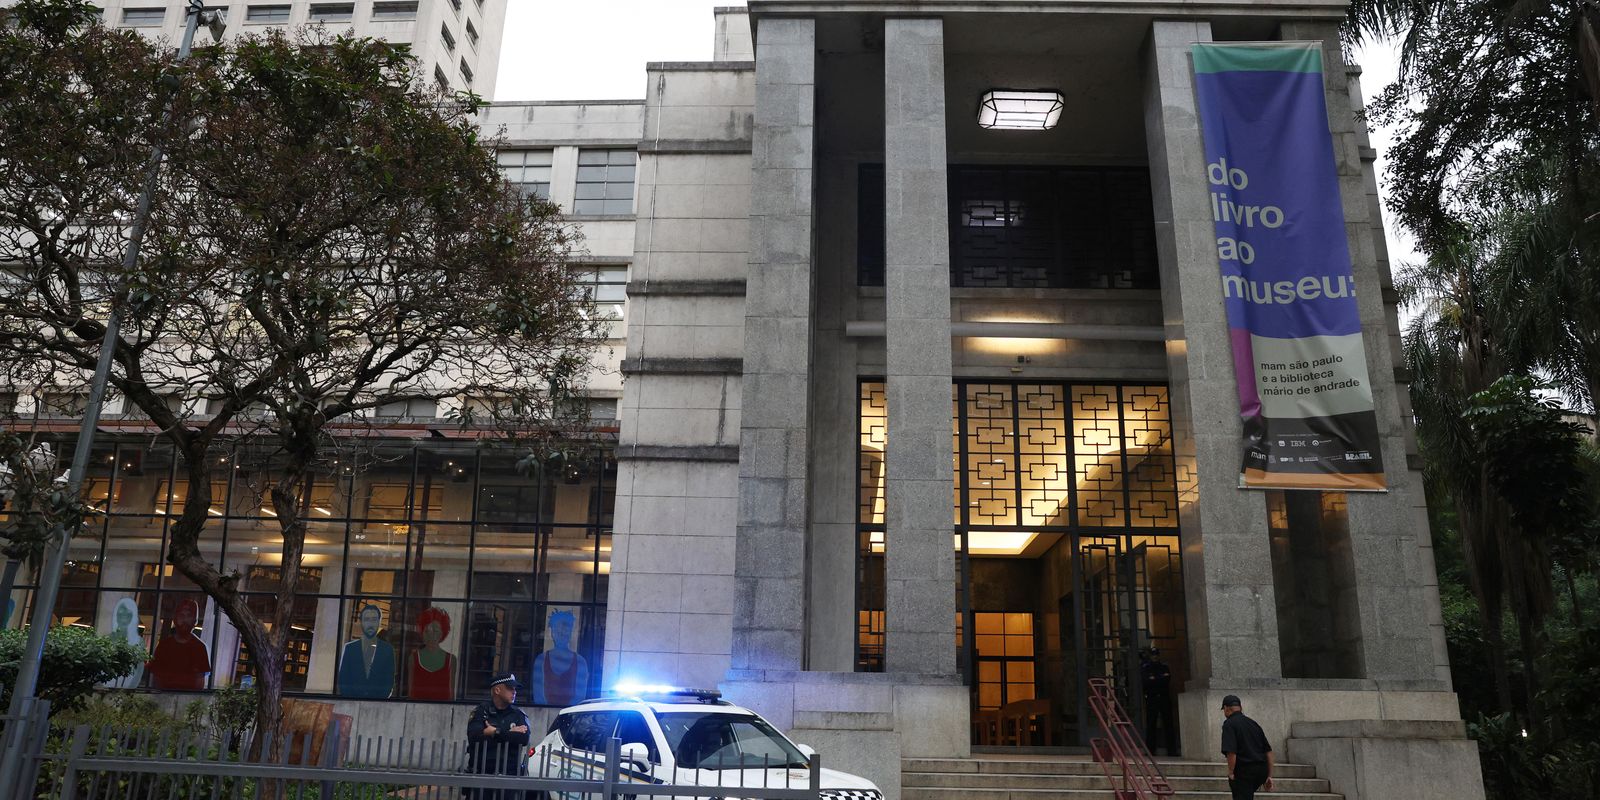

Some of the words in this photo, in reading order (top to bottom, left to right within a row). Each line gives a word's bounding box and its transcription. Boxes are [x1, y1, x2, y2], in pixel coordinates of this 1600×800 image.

[1207, 157, 1249, 190] do
[1211, 192, 1285, 228] livro
[1217, 237, 1255, 265] ao
[1222, 275, 1357, 304] museu:
[1261, 362, 1286, 370] mam
[1289, 360, 1309, 370] são
[1312, 354, 1343, 369] paulo
[1271, 375, 1277, 383] a
[1280, 369, 1334, 383] biblioteca
[1263, 386, 1293, 395] mário
[1296, 386, 1310, 395] de
[1313, 378, 1360, 393] andrade
